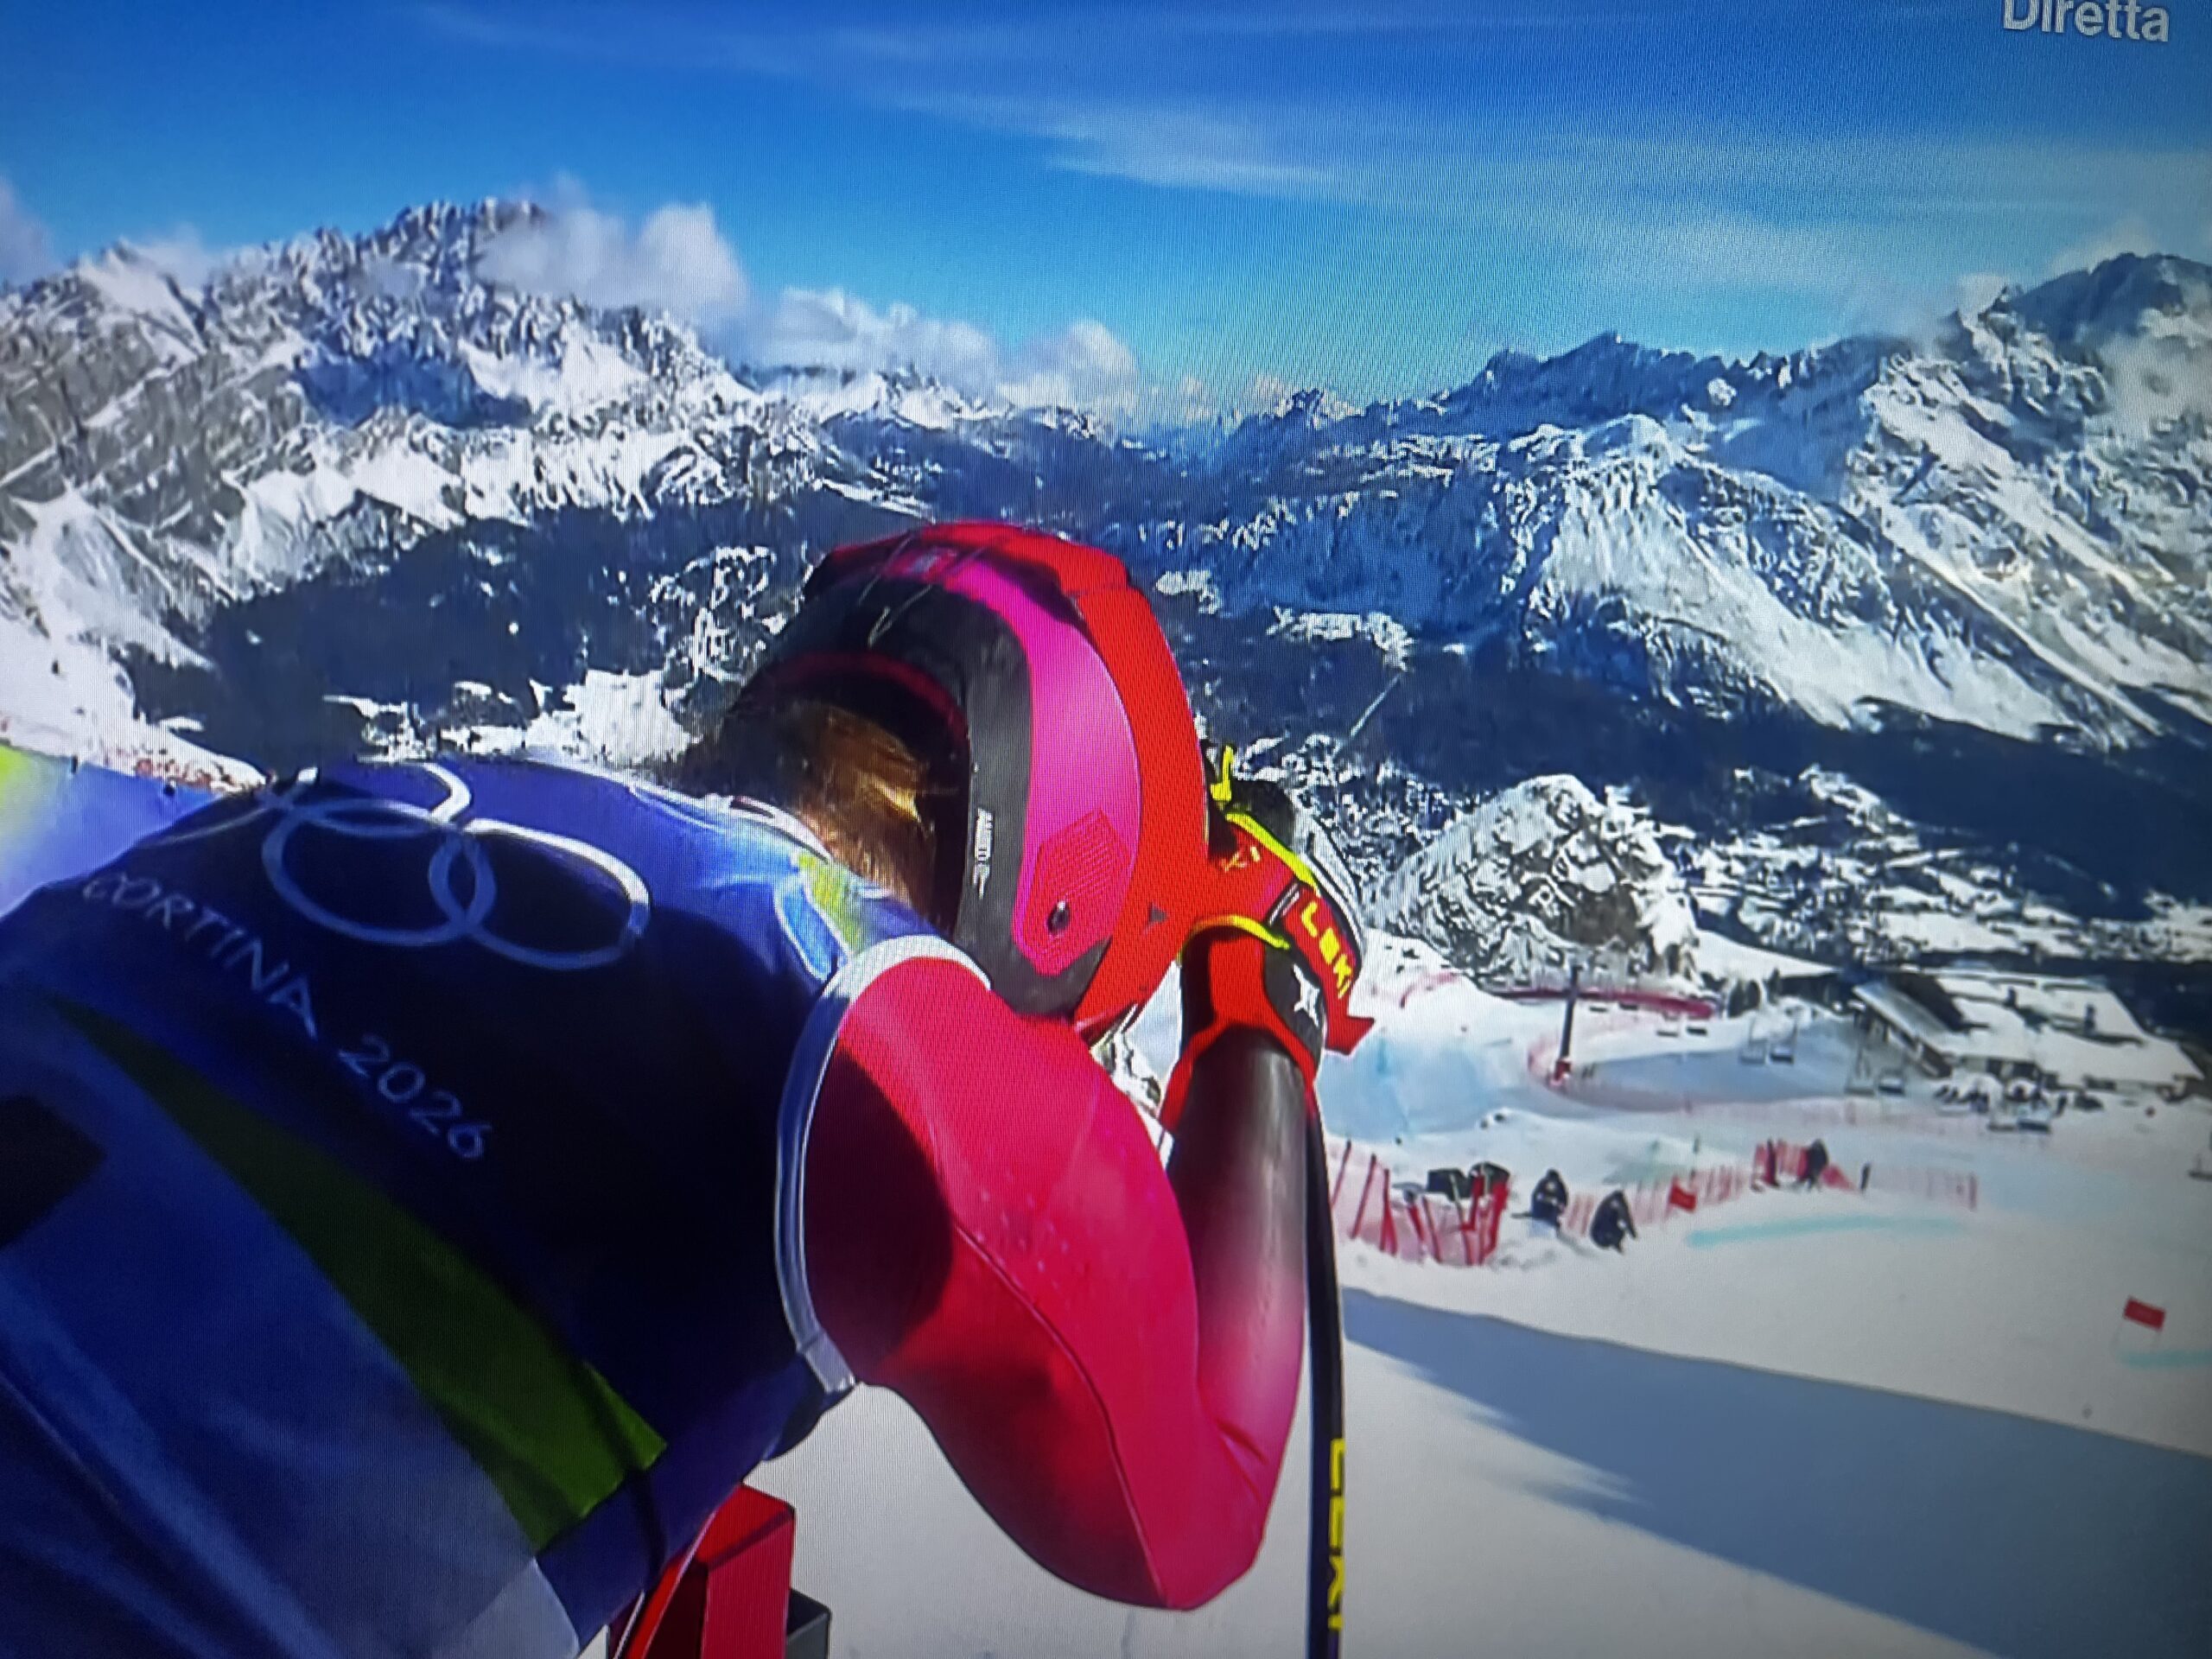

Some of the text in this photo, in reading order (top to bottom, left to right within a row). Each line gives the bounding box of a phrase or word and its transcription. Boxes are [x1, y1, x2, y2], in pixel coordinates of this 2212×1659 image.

[2003, 0, 2170, 42] Diretta
[83, 871, 493, 1160] CORTINA 2026
